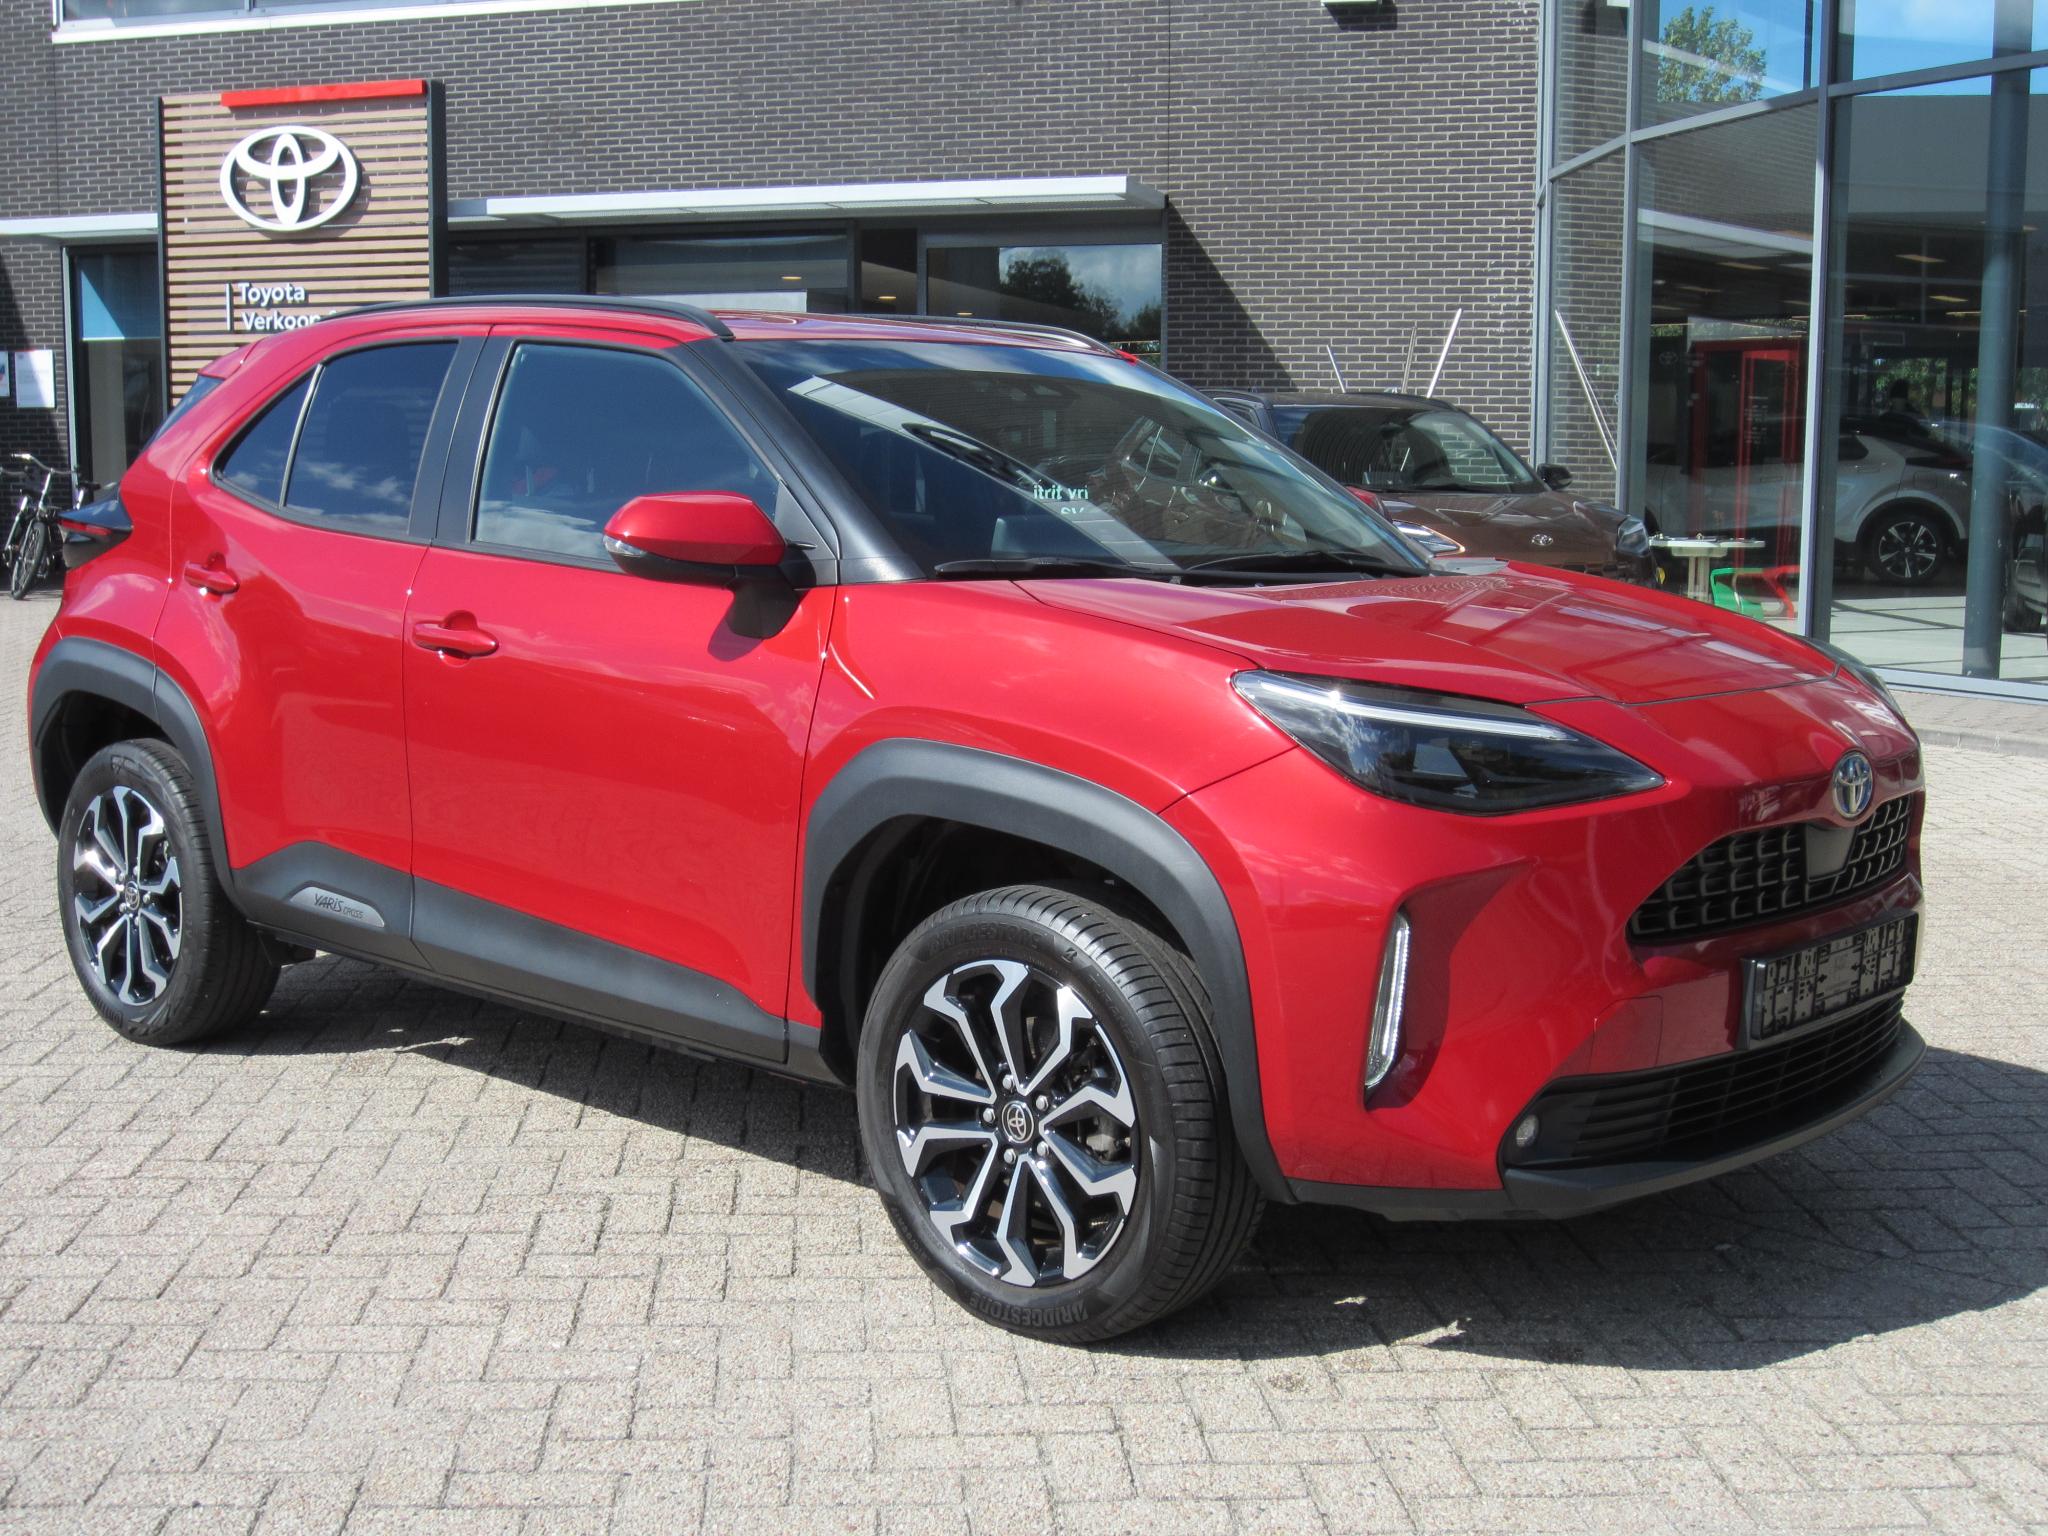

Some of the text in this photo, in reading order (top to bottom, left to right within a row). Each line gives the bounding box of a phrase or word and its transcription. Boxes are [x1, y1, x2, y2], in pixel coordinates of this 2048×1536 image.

[238, 282, 306, 307] Toyota
[314, 893, 344, 912] YARIS
[968, 1291, 1089, 1327] BRIDGESTONE
